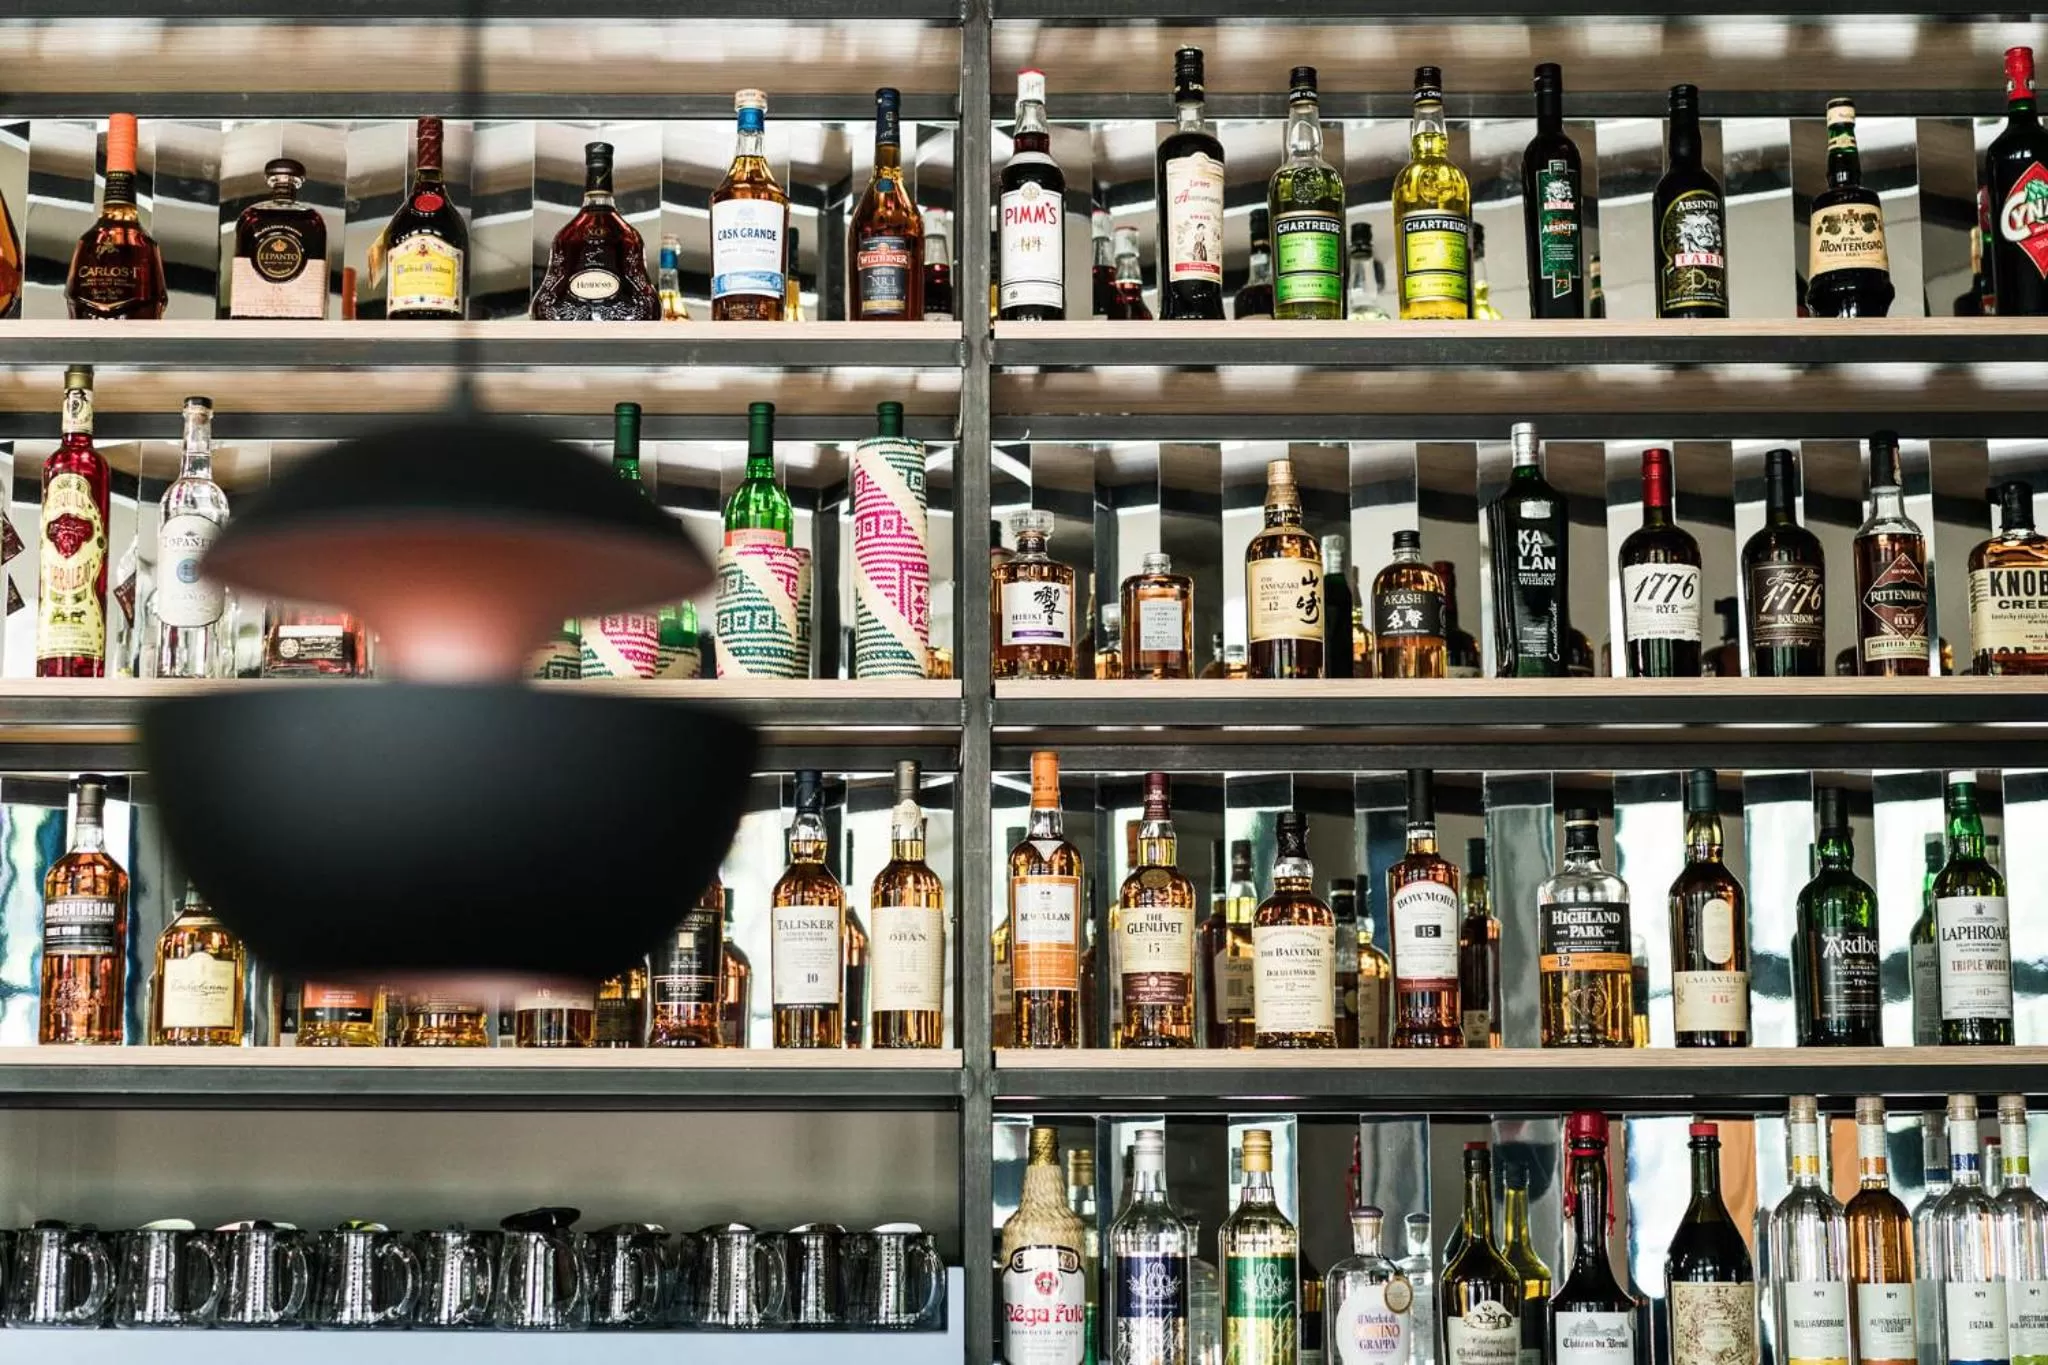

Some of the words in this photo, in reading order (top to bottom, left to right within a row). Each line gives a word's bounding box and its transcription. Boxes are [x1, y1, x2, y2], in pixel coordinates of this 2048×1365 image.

[1676, 199, 1719, 212] ABSINTH
[1004, 202, 1057, 227] PIMM'S
[1277, 220, 1341, 234] CHARTREUSE
[1405, 219, 1469, 233] CHARTREUSE
[718, 228, 739, 241] CASK
[740, 227, 777, 241] GRANDE
[1556, 279, 1569, 289] 73
[1686, 266, 1721, 295] Dry
[1517, 529, 1544, 544] KA
[1517, 543, 1544, 557] VA
[1517, 556, 1557, 570] LAN
[1518, 577, 1557, 587] WHISKY
[1633, 572, 1698, 604] 1776
[1268, 600, 1279, 612] 12
[1655, 604, 1679, 614] RYE
[1012, 613, 1042, 621] HIBIKI
[1777, 613, 1814, 625] BOURBON
[1396, 891, 1456, 910] BOWMORE
[1146, 913, 1163, 921] THE
[1551, 910, 1621, 925] HIGHLAND
[776, 919, 835, 931] TALISKER
[1127, 922, 1184, 935] GLENLIVET
[888, 932, 929, 942] OBAN
[1420, 926, 1435, 937] 15
[1568, 924, 1605, 939] PARK
[1275, 947, 1322, 957] BALVENIE
[1557, 955, 1571, 967] 12
[1951, 959, 1982, 973] TRIPLE
[806, 972, 819, 984] 10
[1968, 1320, 1994, 1329] ENZIAN
[1359, 1339, 1397, 1350] GRAPPA
